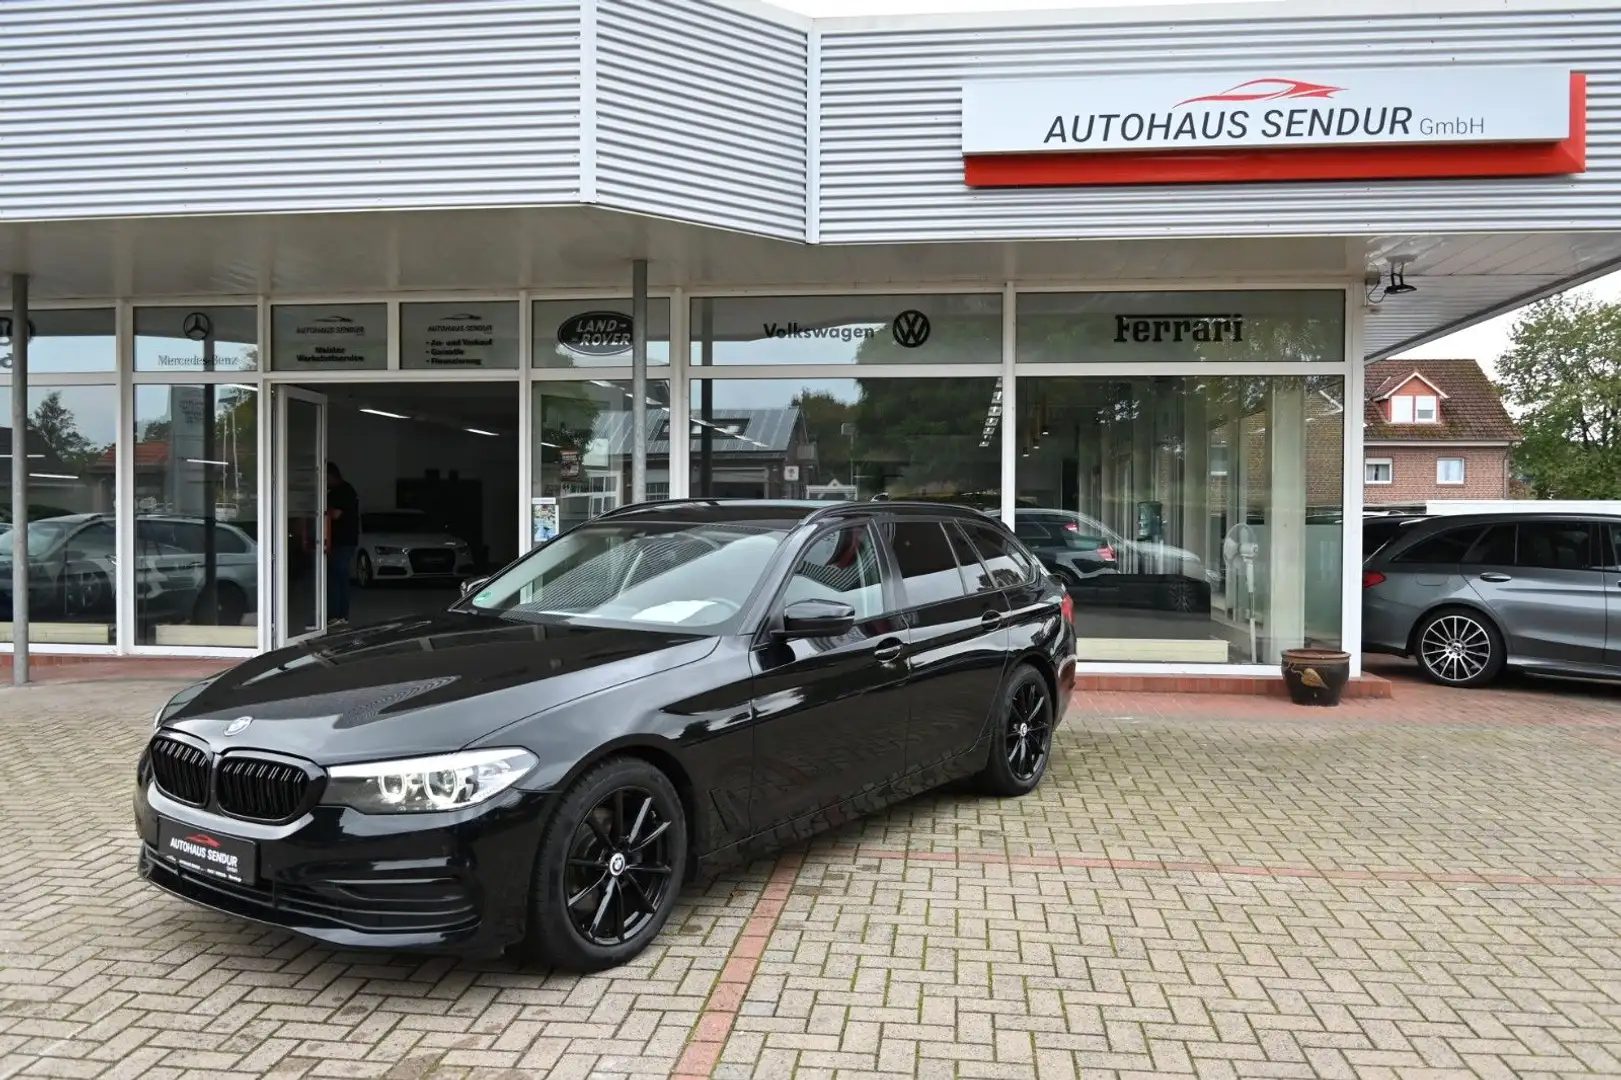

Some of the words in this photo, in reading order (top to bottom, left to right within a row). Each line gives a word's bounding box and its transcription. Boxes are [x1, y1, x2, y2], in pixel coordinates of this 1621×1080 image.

[1043, 110, 1250, 143] AUTOHAUS
[1261, 106, 1413, 138] SENDUR
[1419, 116, 1485, 135] GmbH
[763, 322, 876, 342] Volkswagen
[1113, 313, 1243, 342] Ferrari
[158, 354, 238, 366] Mercedes-Benz
[170, 837, 207, 858] AUTOHAUS
[207, 848, 239, 867] SENDUR
